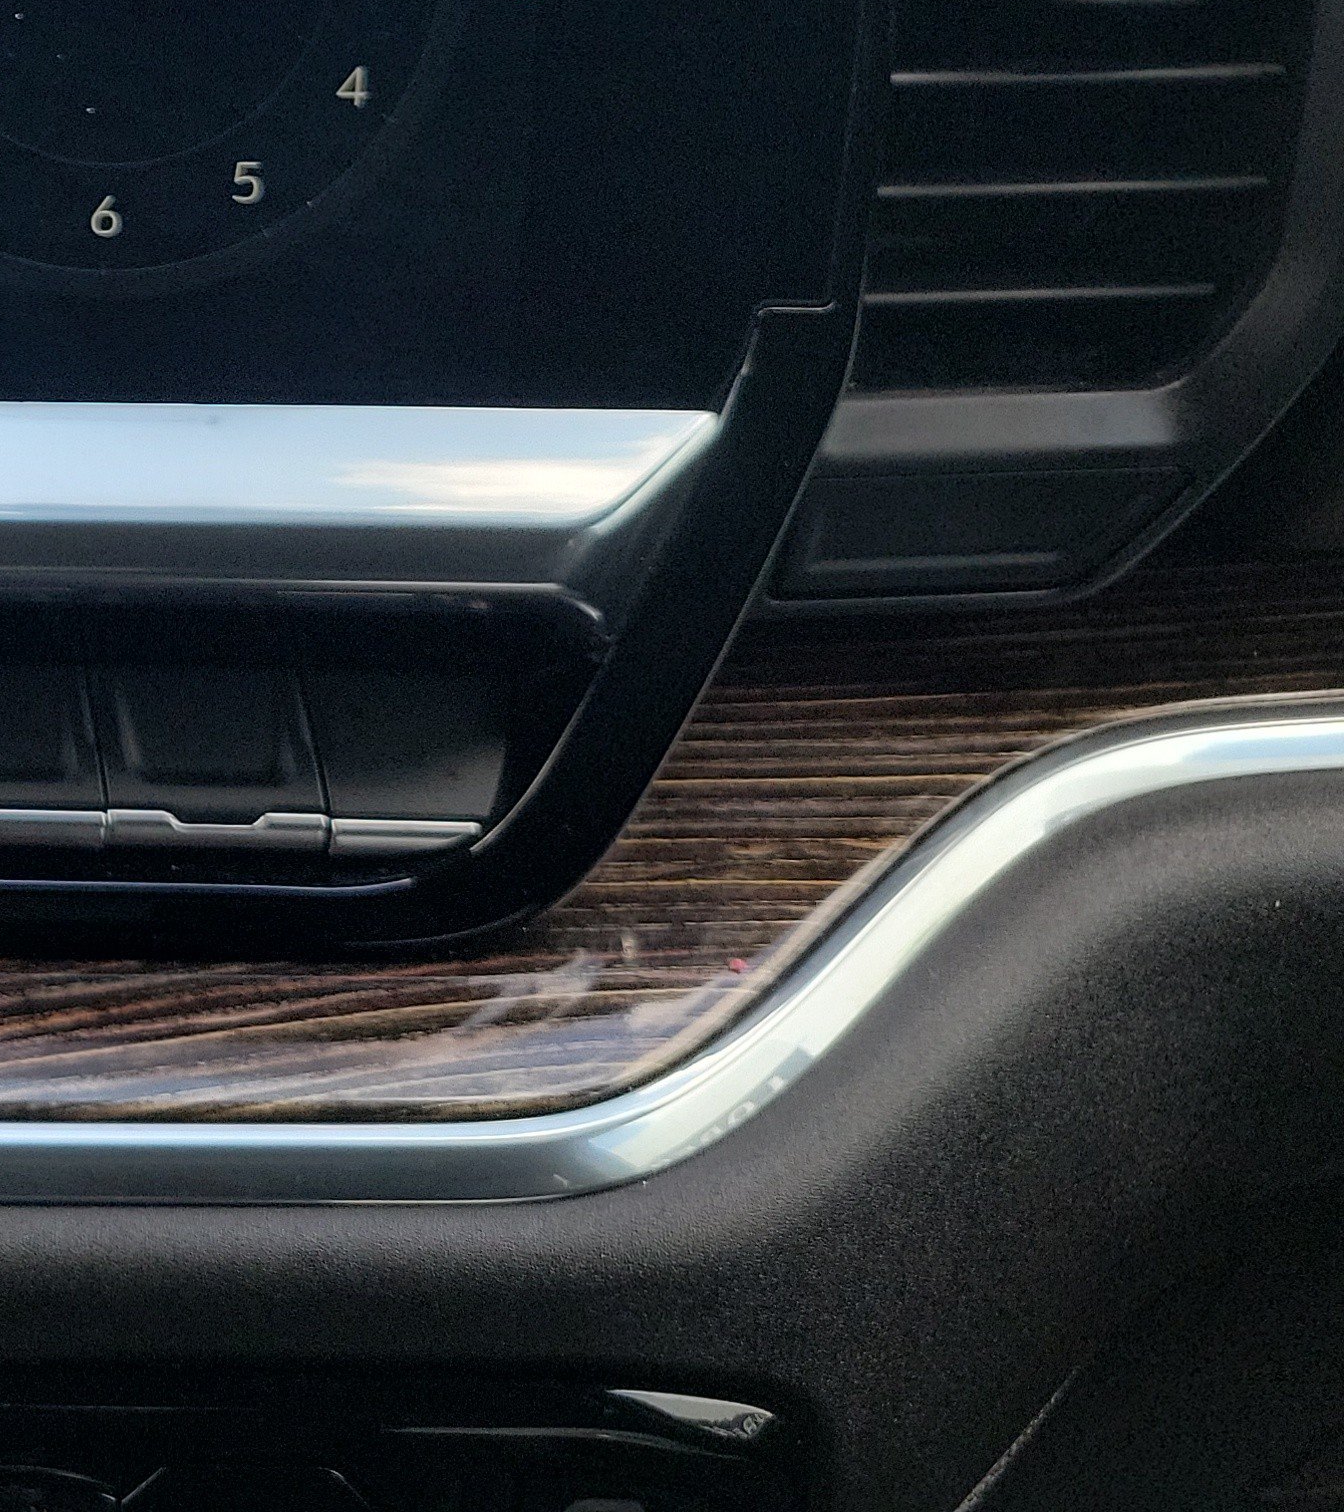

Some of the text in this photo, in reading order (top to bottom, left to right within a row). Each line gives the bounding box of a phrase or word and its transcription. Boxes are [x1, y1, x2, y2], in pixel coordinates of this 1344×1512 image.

[335, 66, 370, 107] 4
[232, 161, 265, 204] 5
[90, 195, 124, 237] 6
